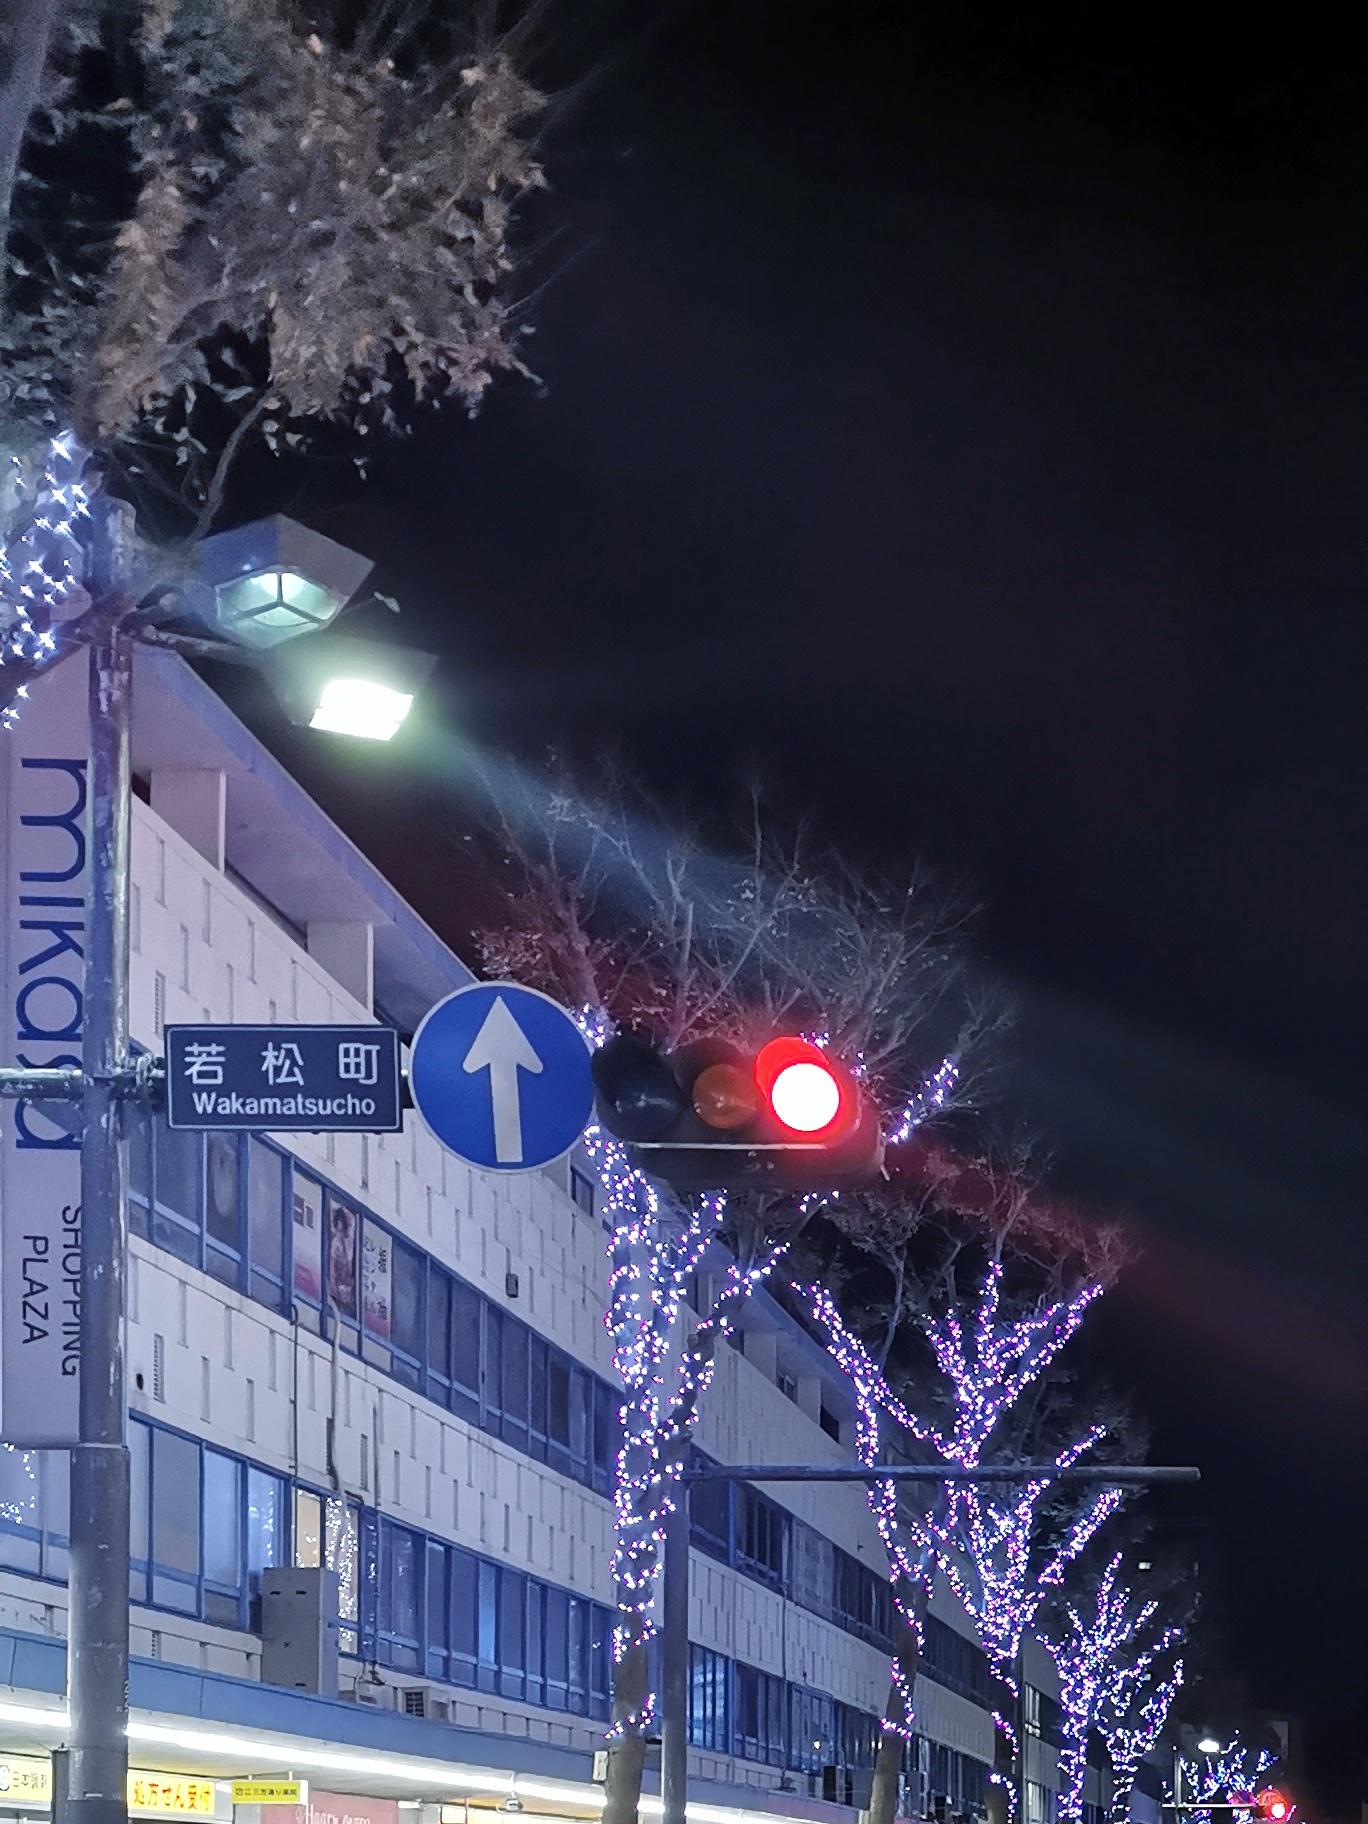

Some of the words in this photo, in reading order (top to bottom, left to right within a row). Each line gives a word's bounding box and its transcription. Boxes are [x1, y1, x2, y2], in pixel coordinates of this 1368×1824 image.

[183, 1041, 382, 1086] 若松町
[191, 1090, 377, 1116] Wakamatsucho
[22, 1235, 50, 1344] PLAZA
